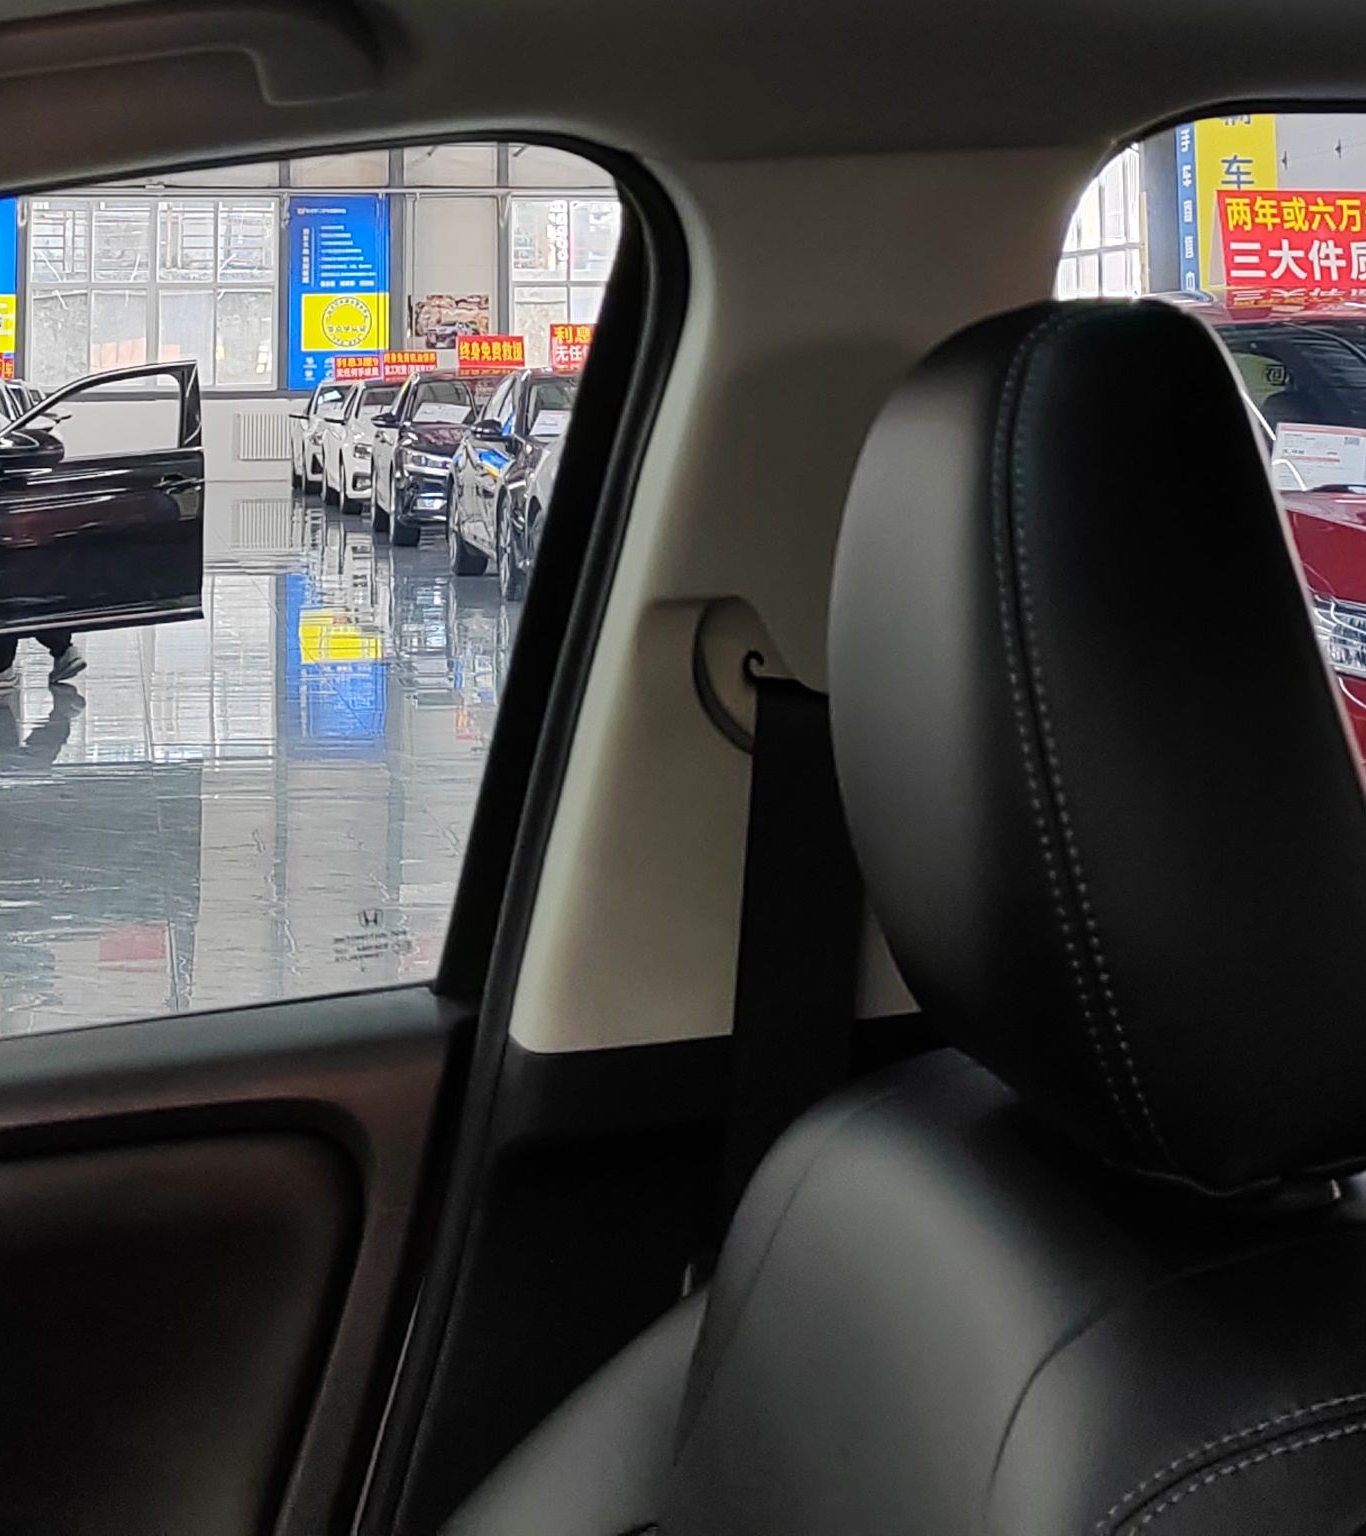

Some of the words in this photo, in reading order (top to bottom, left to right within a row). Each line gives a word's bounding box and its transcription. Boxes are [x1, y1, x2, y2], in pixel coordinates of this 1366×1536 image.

[459, 342, 524, 362] 终身免费救援
